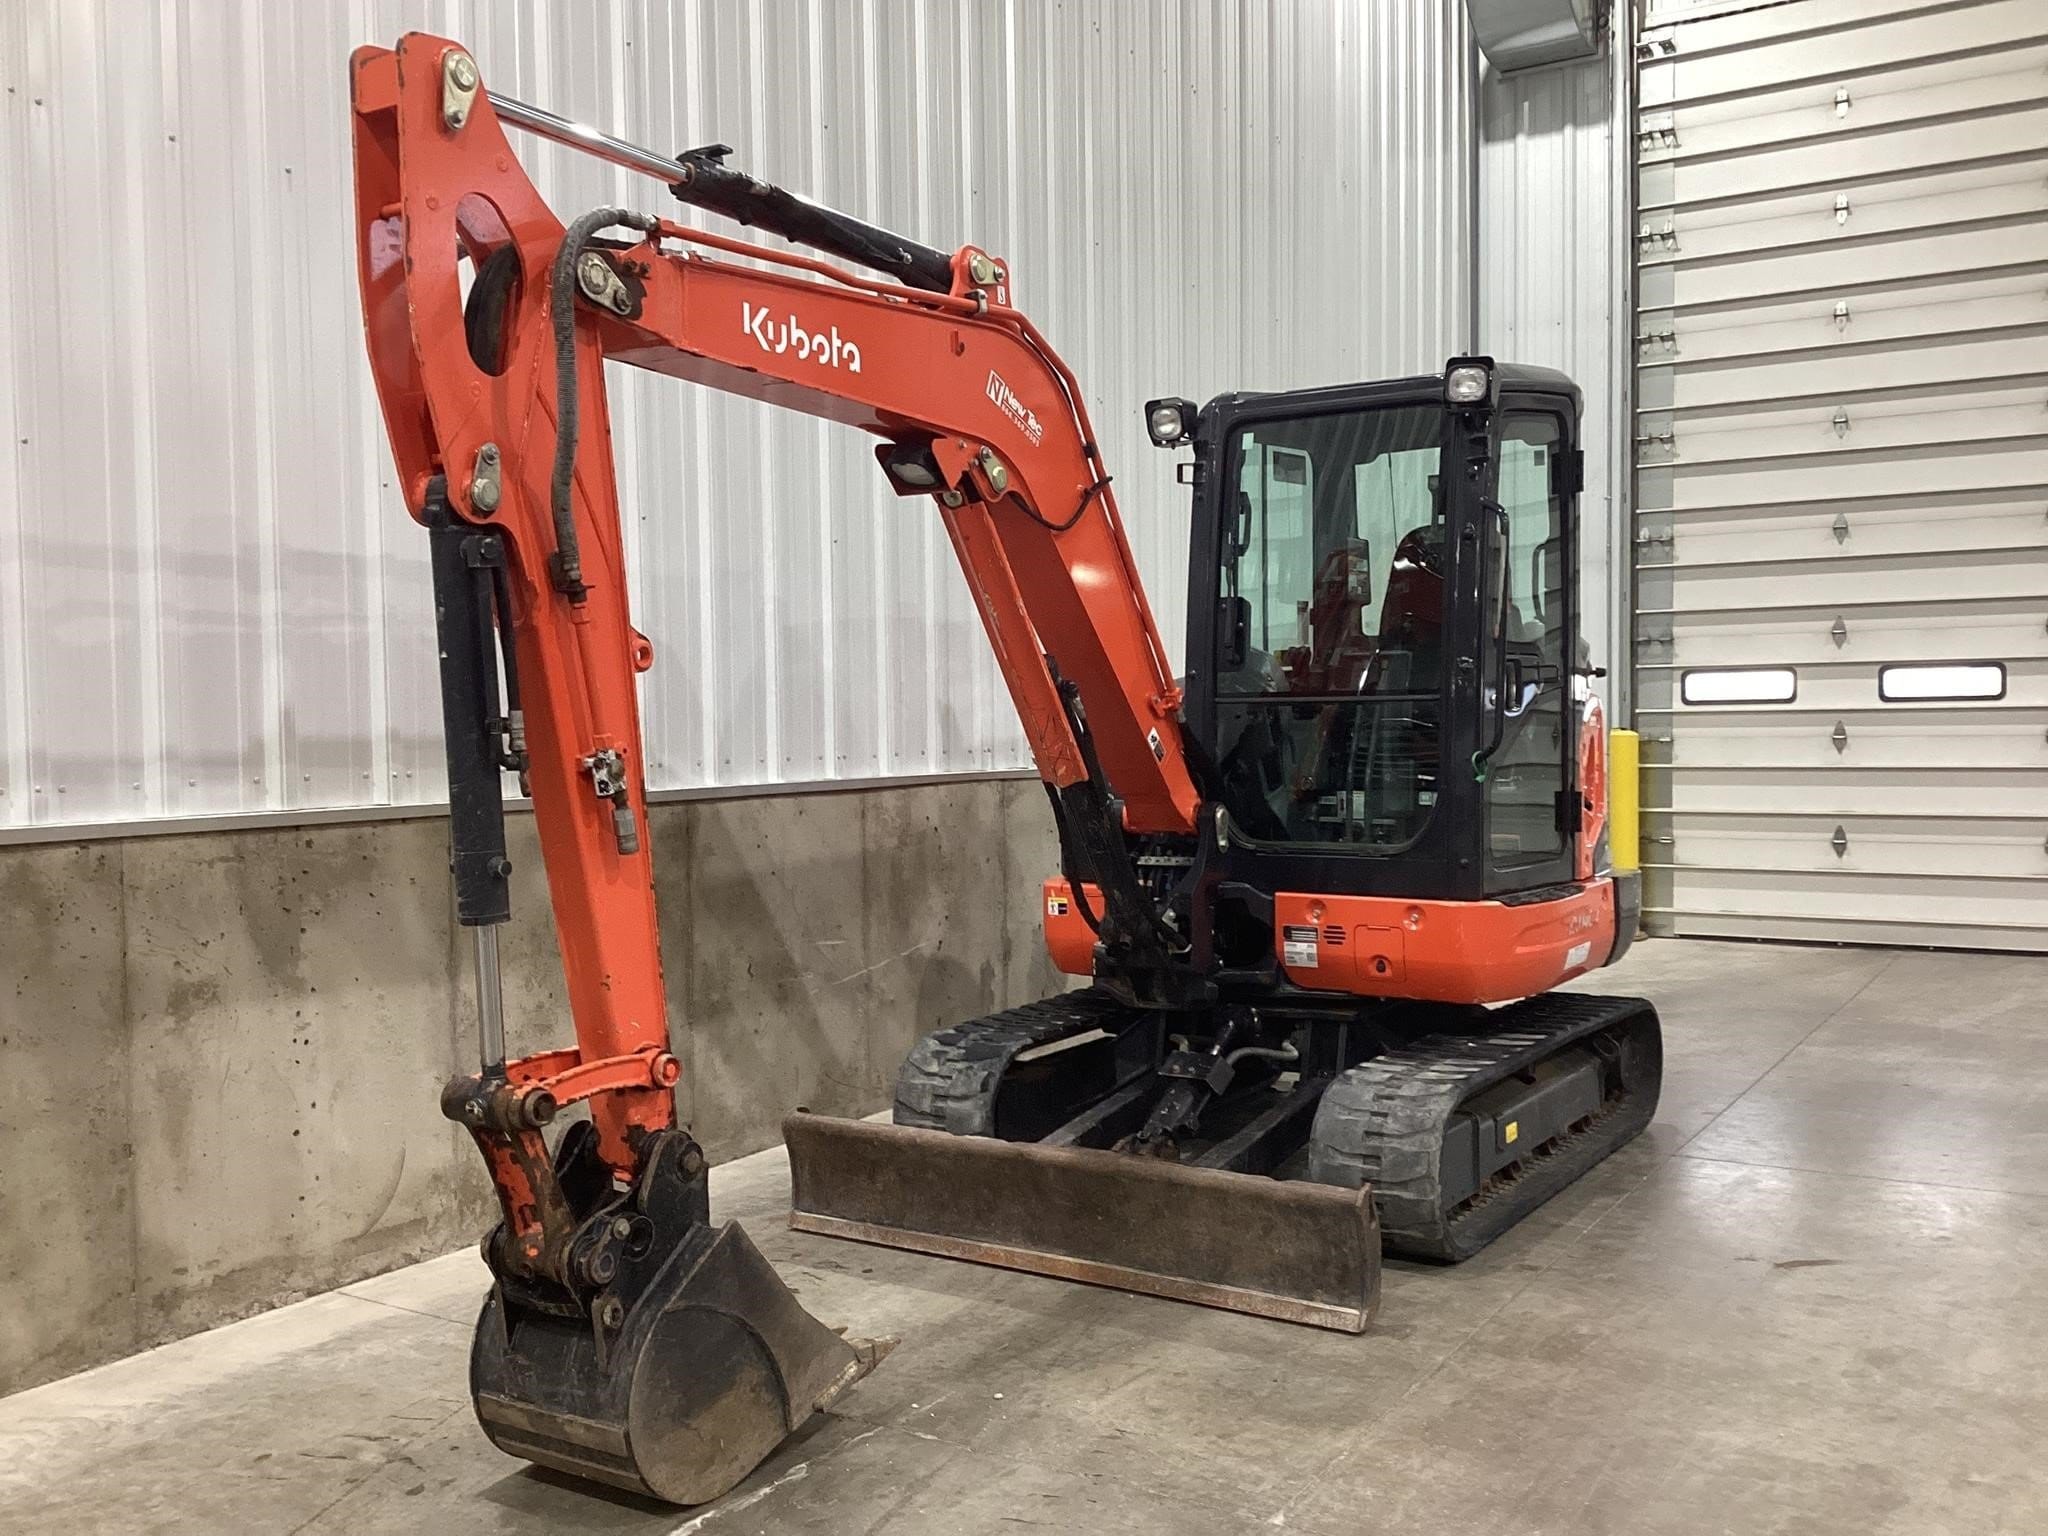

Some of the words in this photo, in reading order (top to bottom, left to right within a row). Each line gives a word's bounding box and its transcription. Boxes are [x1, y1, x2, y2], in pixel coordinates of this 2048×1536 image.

[742, 301, 861, 374] Kubota
[1003, 386, 1026, 418] New
[1027, 409, 1043, 436] Tec
